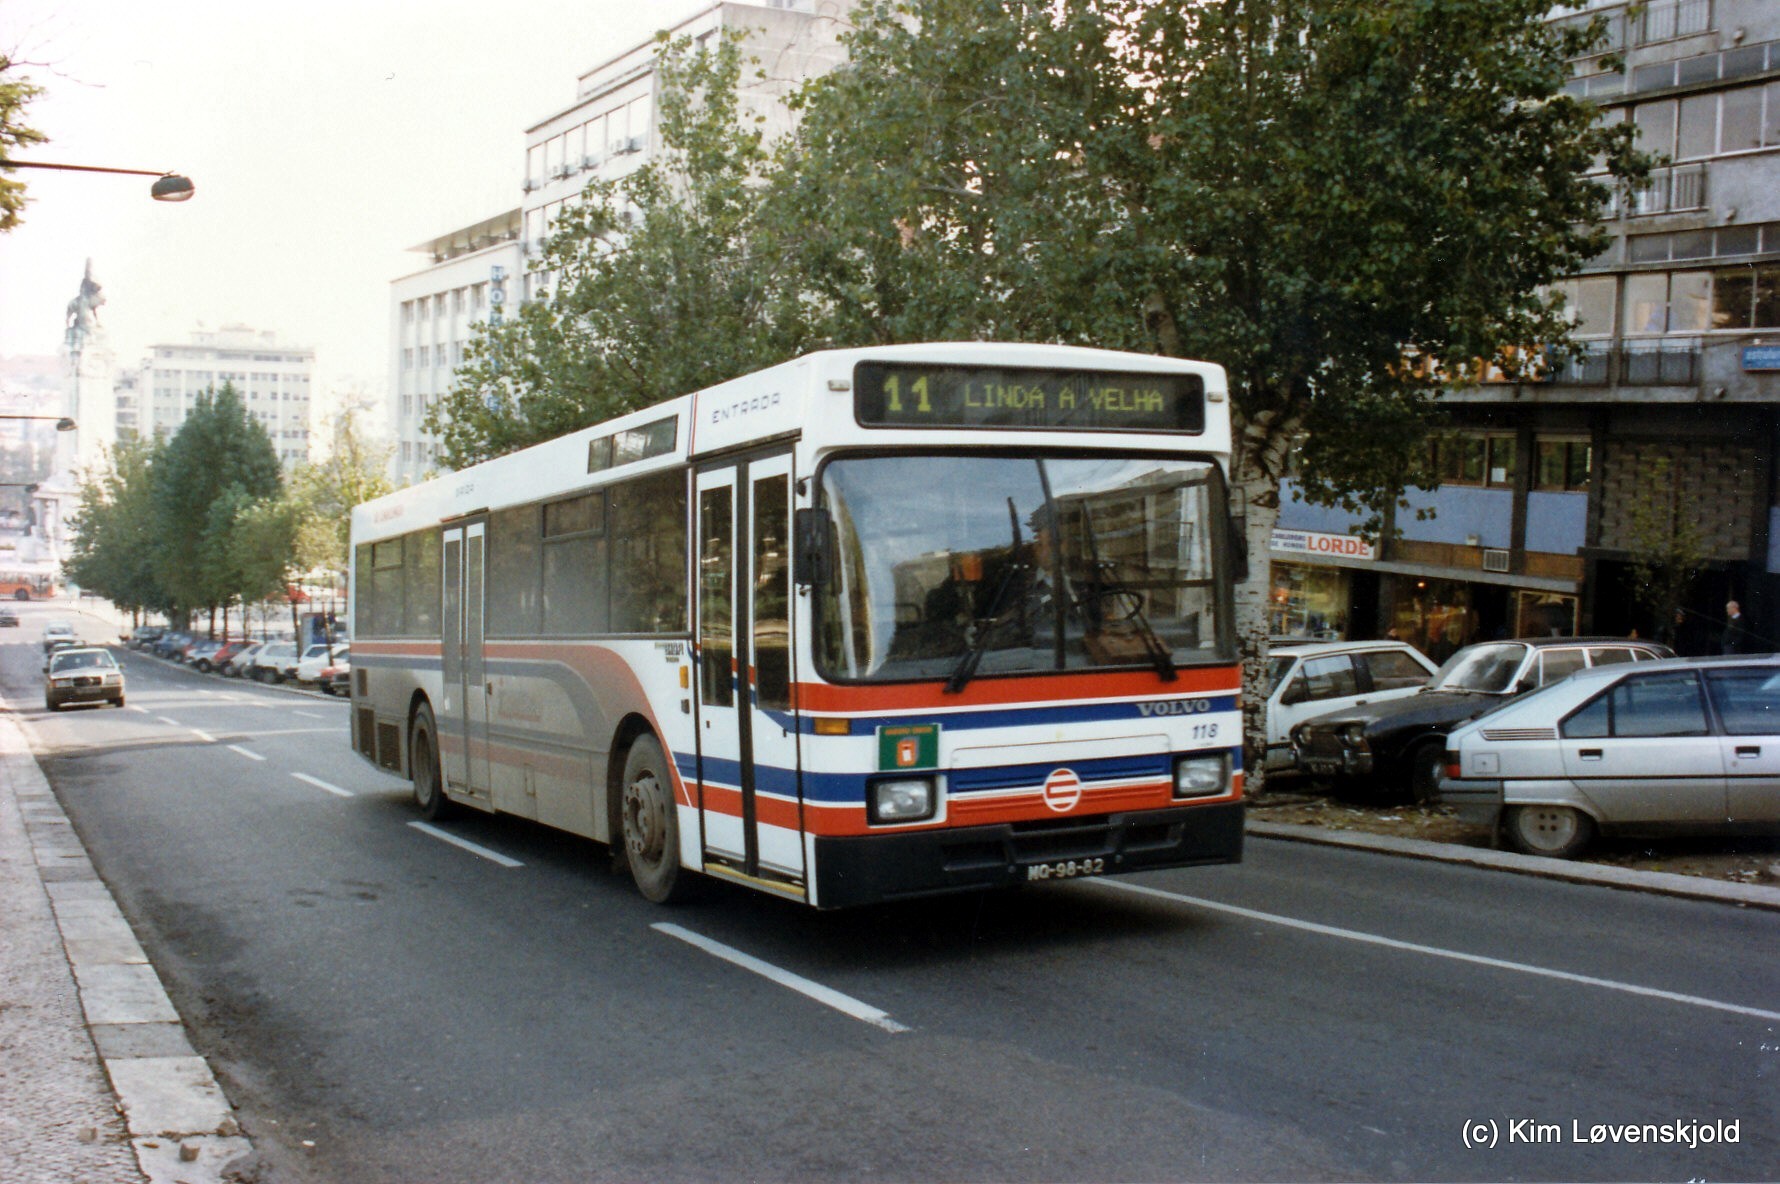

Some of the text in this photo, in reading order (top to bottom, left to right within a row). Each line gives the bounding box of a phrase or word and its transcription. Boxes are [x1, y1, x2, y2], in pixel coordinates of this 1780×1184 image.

[883, 374, 1164, 412] 11 LINDA A VELHA
[712, 392, 781, 424] ENTRADA
[1307, 536, 1369, 556] LORDE
[1137, 699, 1211, 717] VOLVO
[1193, 723, 1219, 740] 118
